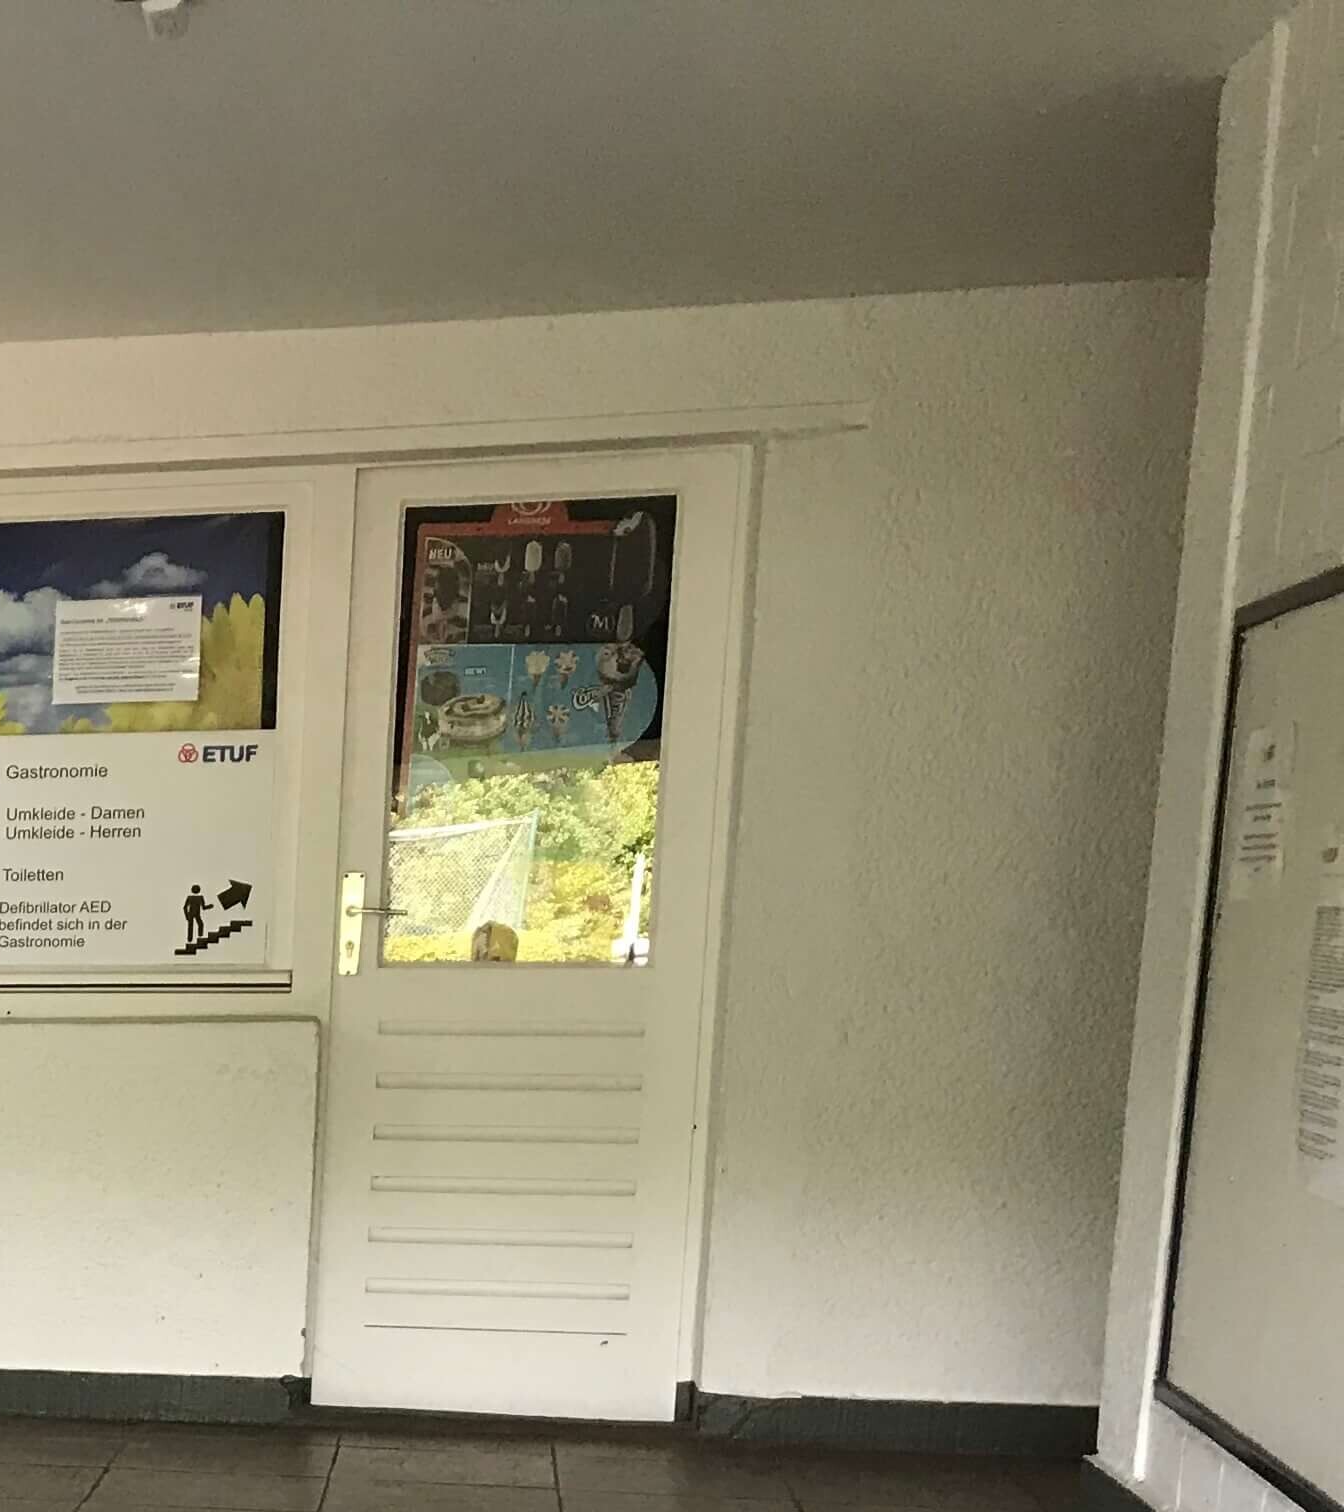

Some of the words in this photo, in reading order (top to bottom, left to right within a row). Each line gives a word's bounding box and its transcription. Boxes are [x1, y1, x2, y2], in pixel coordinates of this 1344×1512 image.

[429, 549, 452, 560] NEU
[202, 744, 258, 763] ETUF
[5, 764, 108, 780] Gastronomie
[6, 807, 75, 821] Umkleide
[91, 806, 145, 820] Damen
[5, 825, 75, 840] Umkleide
[90, 825, 142, 839] Herren
[2, 868, 64, 882] Toiletten
[0, 901, 77, 914] Defibrillator
[79, 900, 112, 913] AED
[56, 918, 84, 931] sich
[88, 918, 100, 930] in
[104, 917, 128, 930] der
